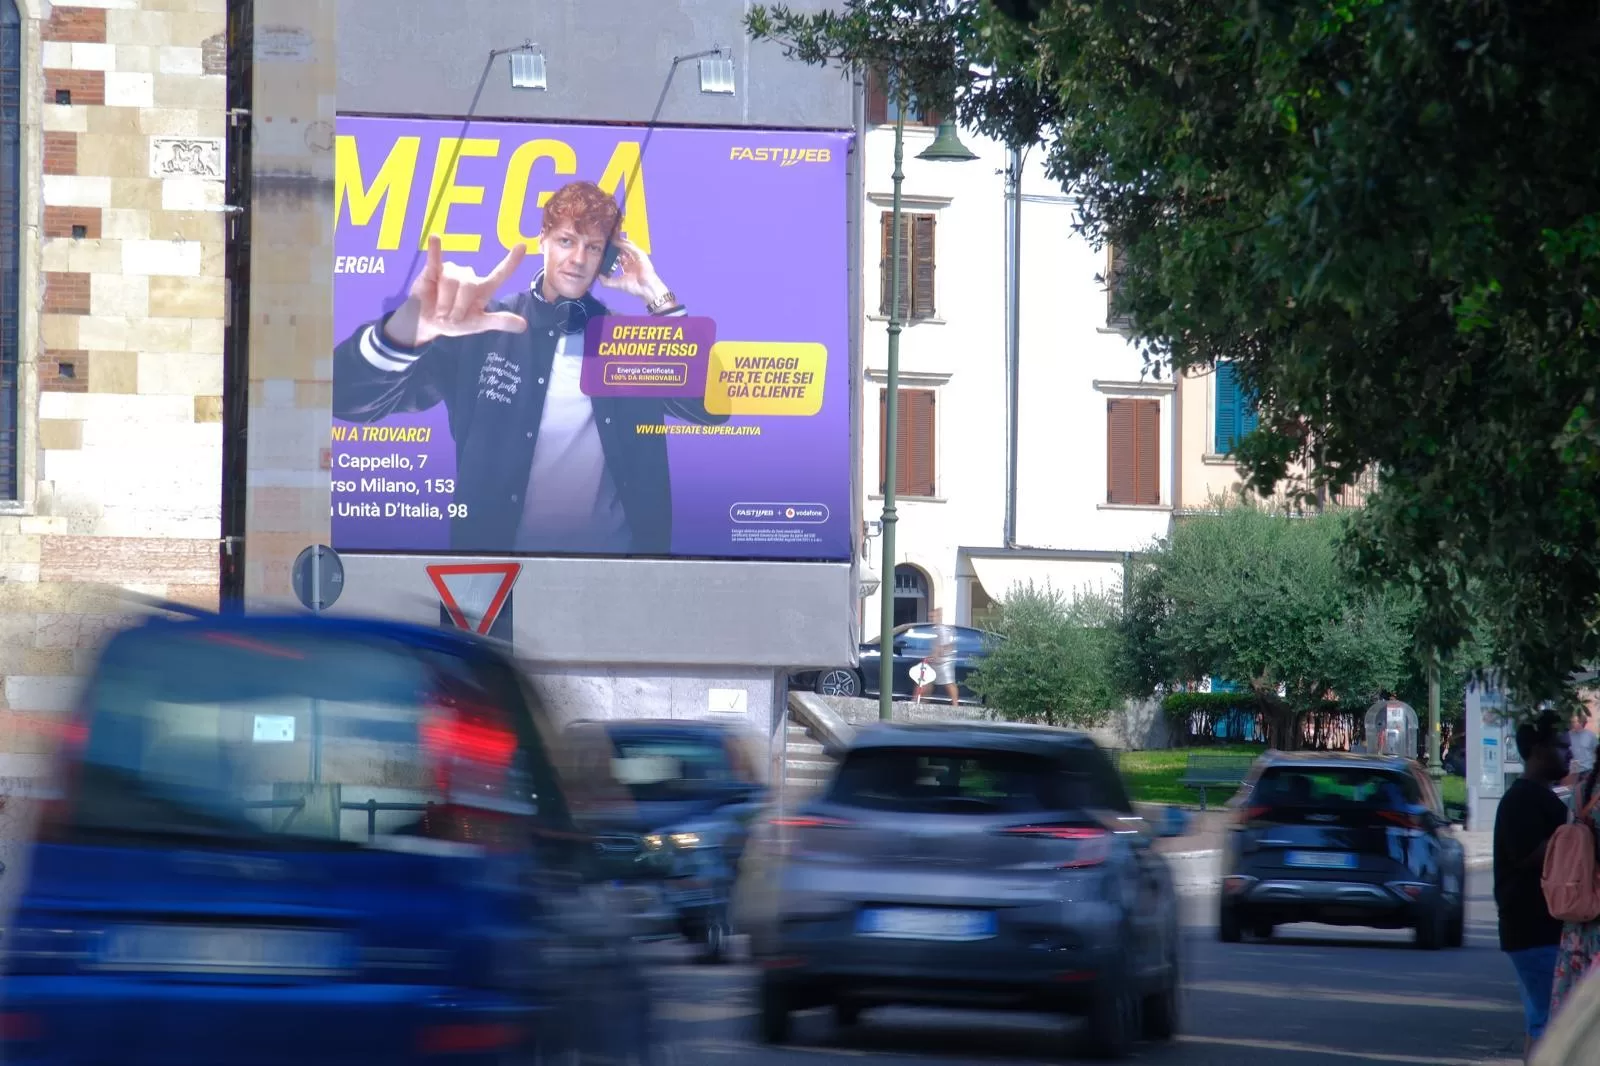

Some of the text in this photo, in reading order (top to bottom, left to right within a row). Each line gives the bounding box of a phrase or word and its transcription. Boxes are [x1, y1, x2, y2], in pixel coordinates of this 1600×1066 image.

[730, 147, 831, 167] FASTWEB
[334, 135, 652, 255] MEGA
[612, 325, 684, 341] OFFERTE A
[598, 342, 698, 357] CANONE FISSO
[617, 367, 640, 375] Energia
[734, 356, 800, 370] VANTAGGI
[628, 374, 638, 382] DA
[718, 370, 815, 385] PER TE CHE SEI
[727, 382, 807, 399] GIÀ CLIENTE
[347, 426, 359, 441] A
[361, 426, 432, 443] TROVARCI
[635, 424, 762, 436] VIVI UN'ESTATE SUPERLATIVA
[338, 453, 414, 472] Cappello,
[417, 454, 429, 469] 7
[360, 477, 421, 496] Milano,
[424, 479, 456, 494] 153
[338, 501, 381, 518] Unità
[447, 503, 469, 519] 98
